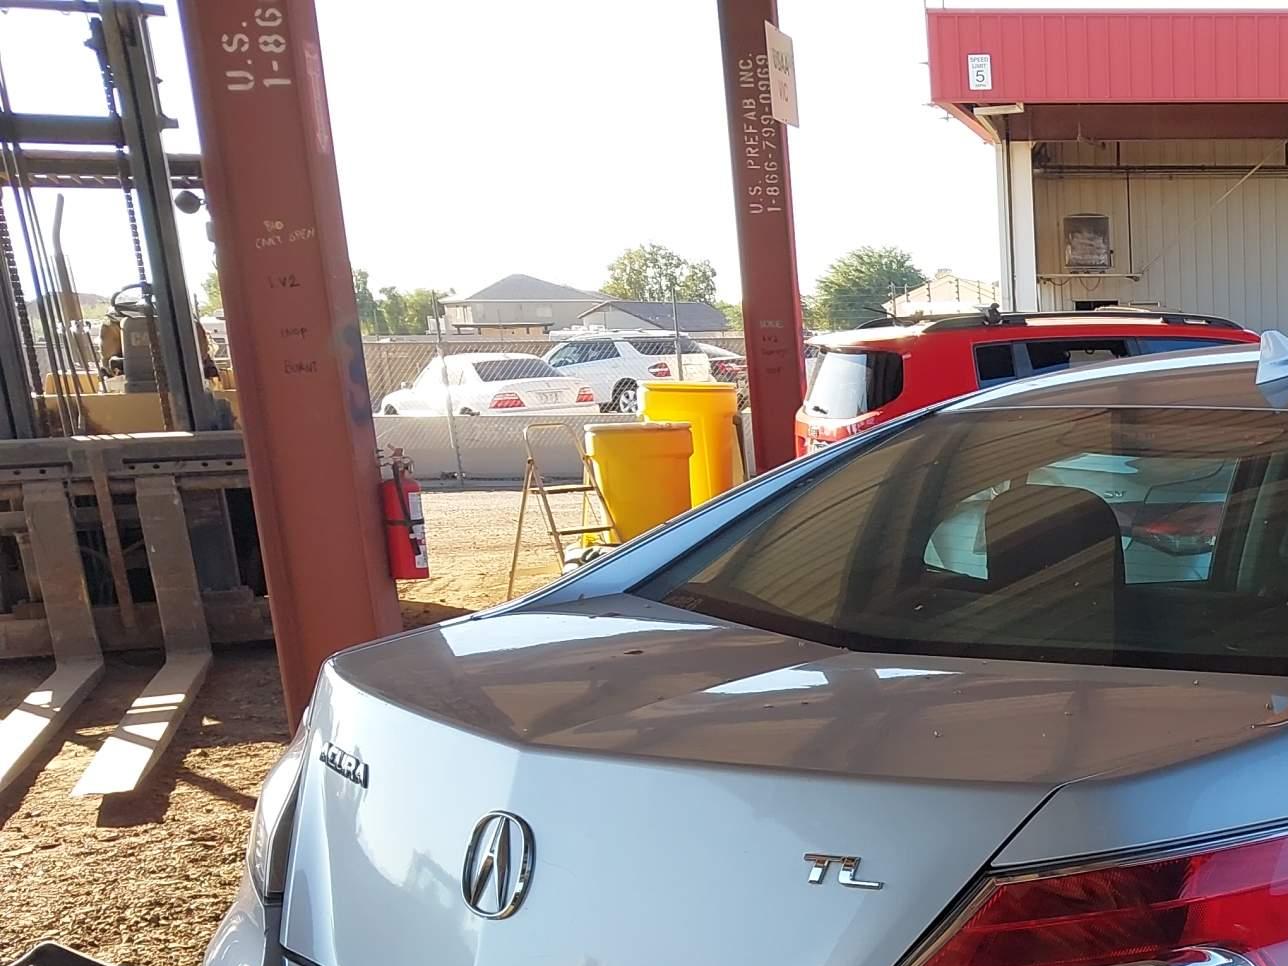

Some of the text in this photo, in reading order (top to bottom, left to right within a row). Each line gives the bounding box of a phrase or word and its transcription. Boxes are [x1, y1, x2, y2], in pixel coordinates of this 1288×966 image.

[222, 21, 255, 90] U.S.
[255, 0, 291, 87] 1-86
[976, 70, 985, 82] 5
[738, 53, 764, 214] U.S. PREFAB INC.
[804, 853, 885, 891] TL
